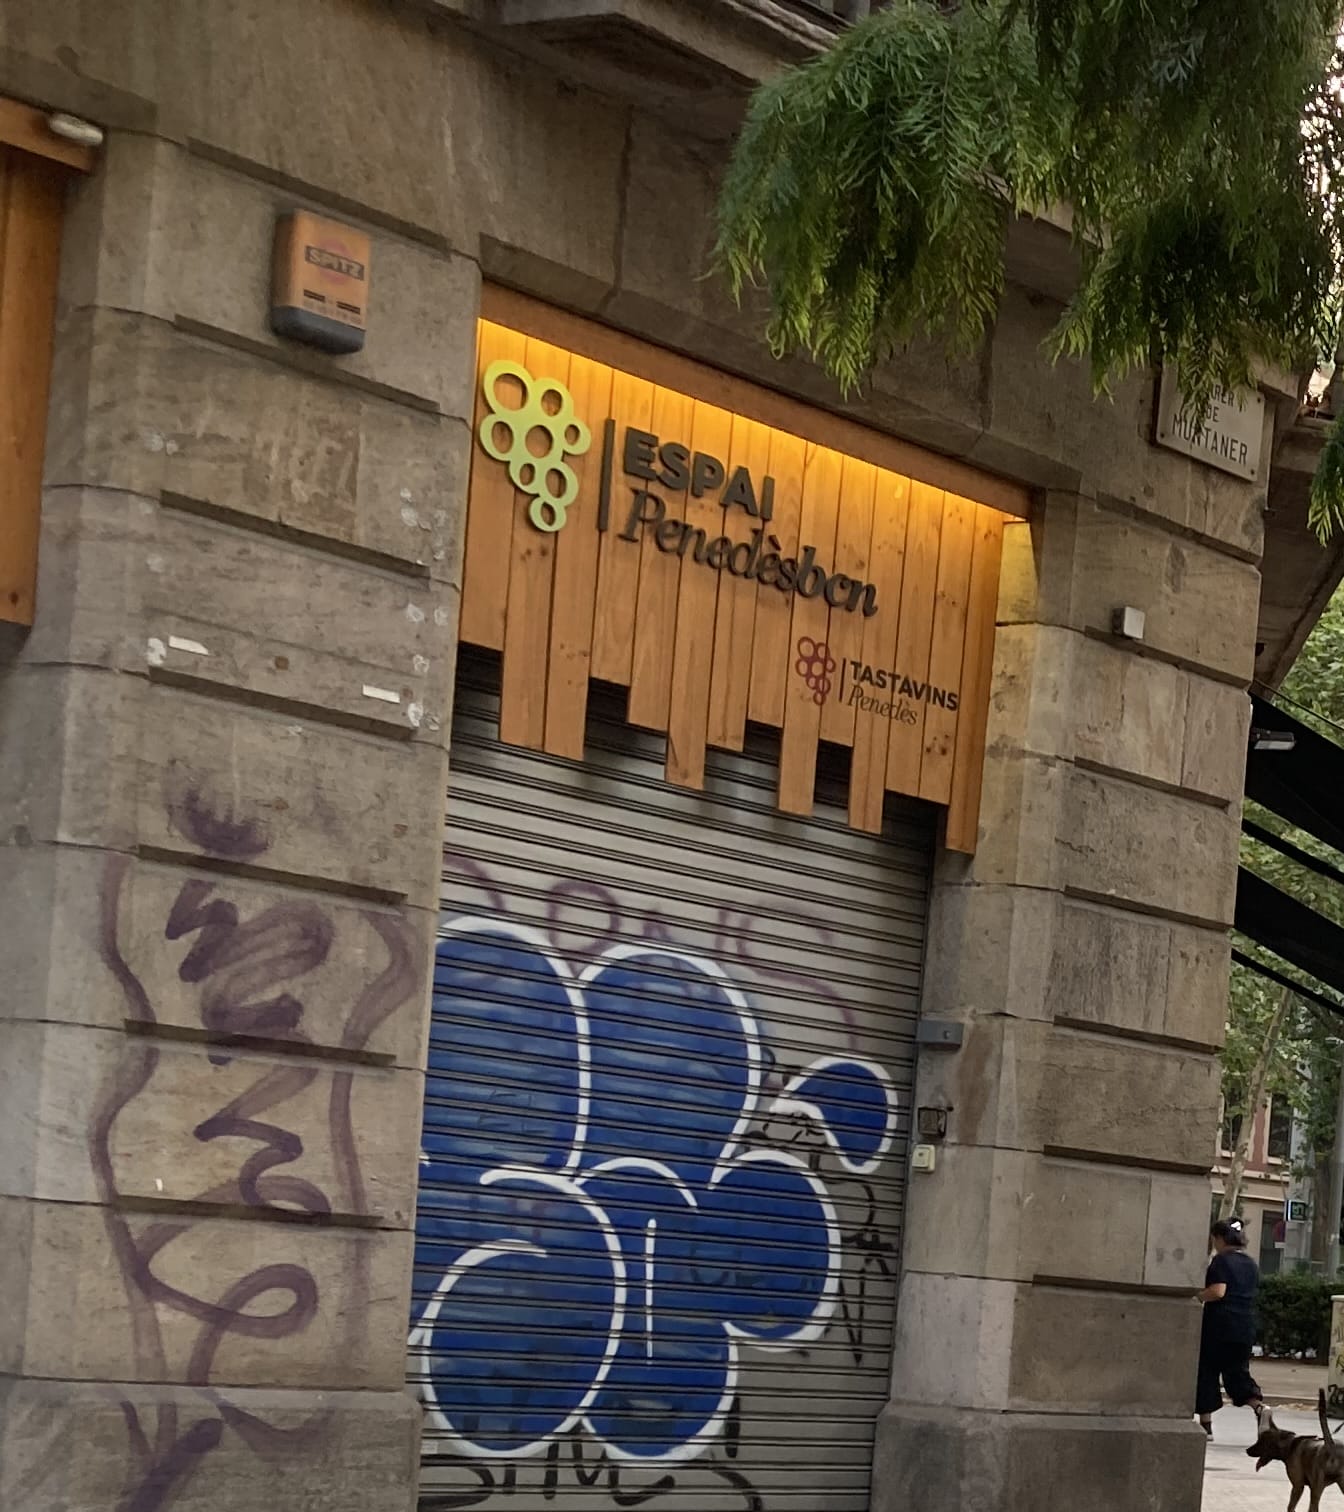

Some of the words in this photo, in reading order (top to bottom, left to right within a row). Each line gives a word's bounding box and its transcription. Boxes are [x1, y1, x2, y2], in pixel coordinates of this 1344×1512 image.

[1206, 405, 1220, 423] DE
[623, 426, 776, 522] ESPAI
[618, 487, 879, 618] Penedèsbcn
[848, 684, 918, 726] Penedès
[850, 660, 959, 712] TASTAVINS
